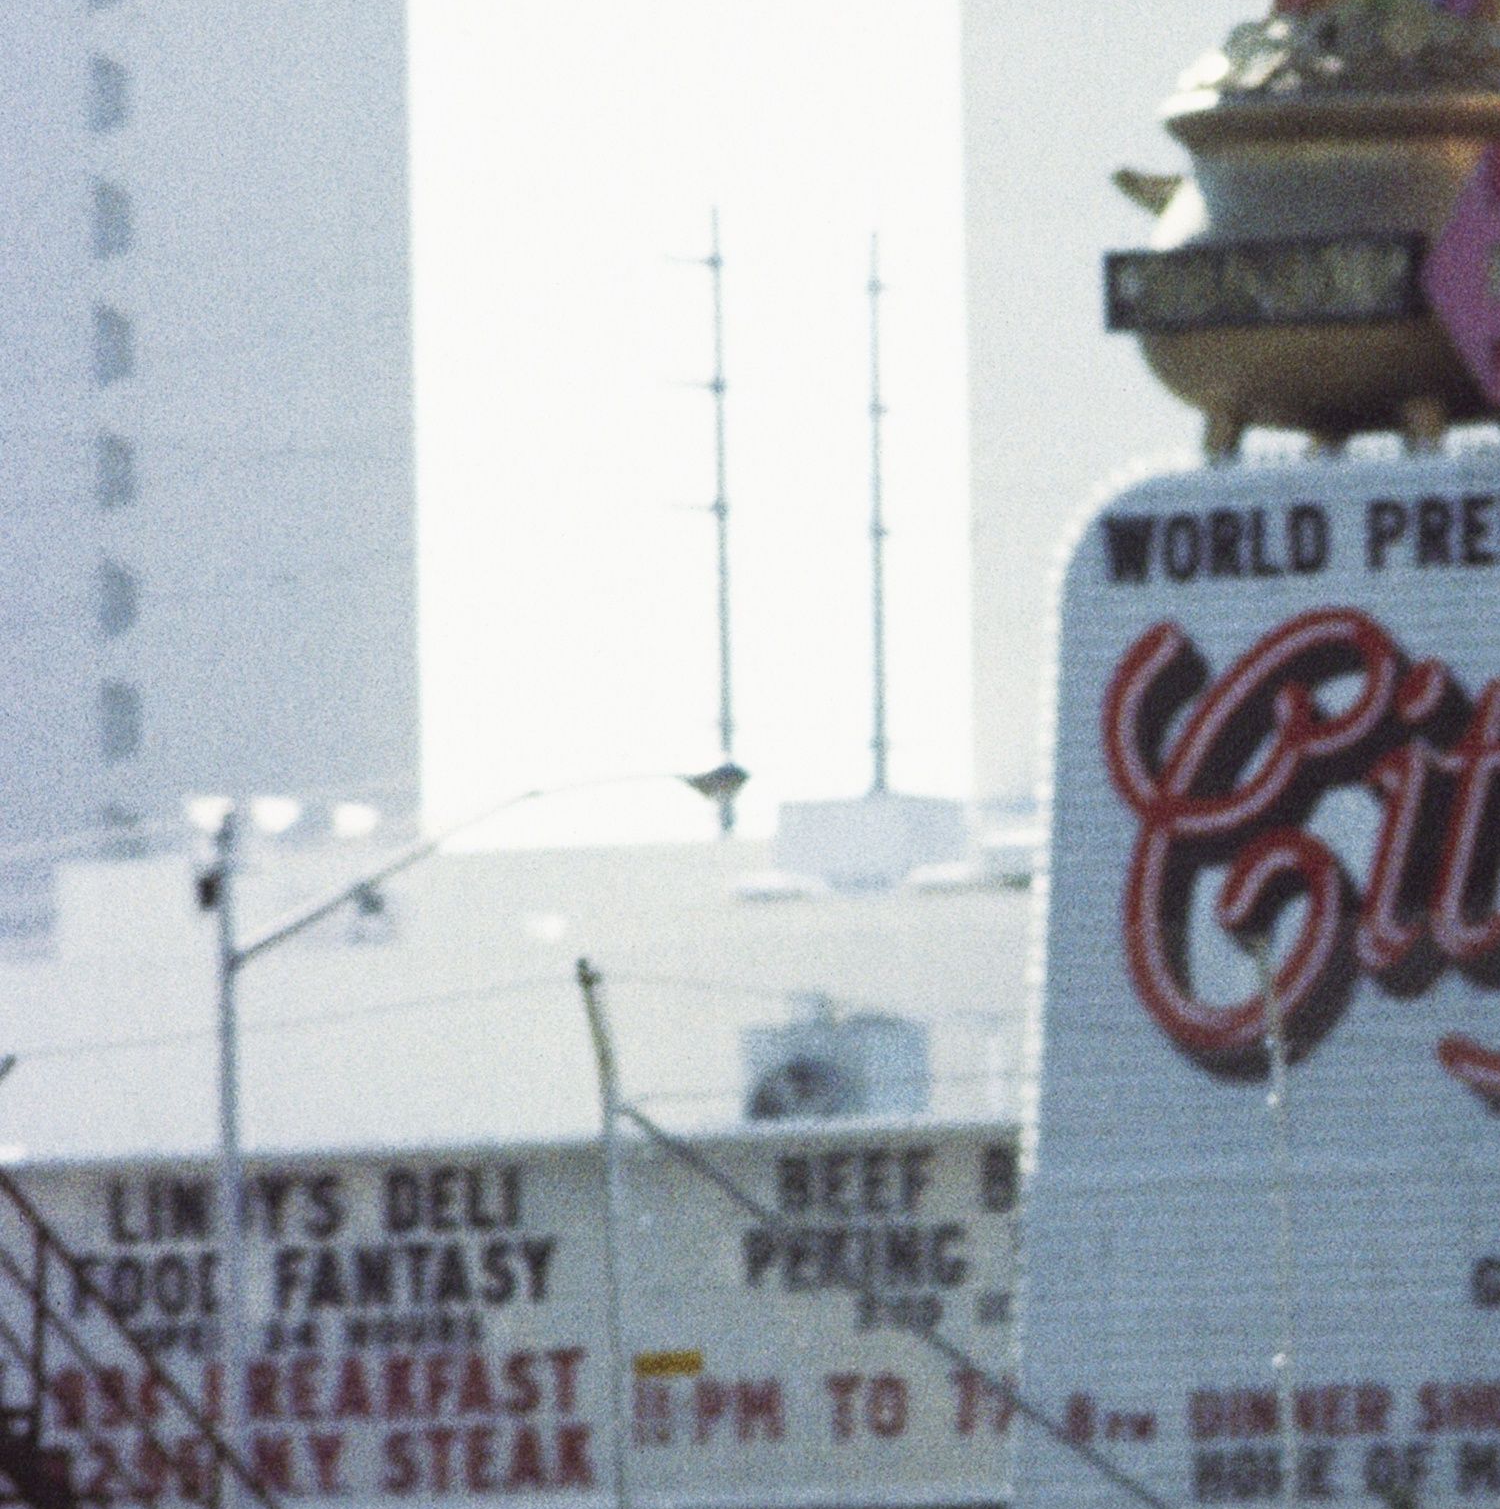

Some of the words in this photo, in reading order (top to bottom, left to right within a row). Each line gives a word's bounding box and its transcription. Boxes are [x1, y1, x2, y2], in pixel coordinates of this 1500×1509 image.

[1102, 503, 1328, 584] WORLD
[385, 1164, 524, 1234] DELI
[273, 1238, 558, 1310] FANTASY
[381, 1422, 594, 1496] STEAK
